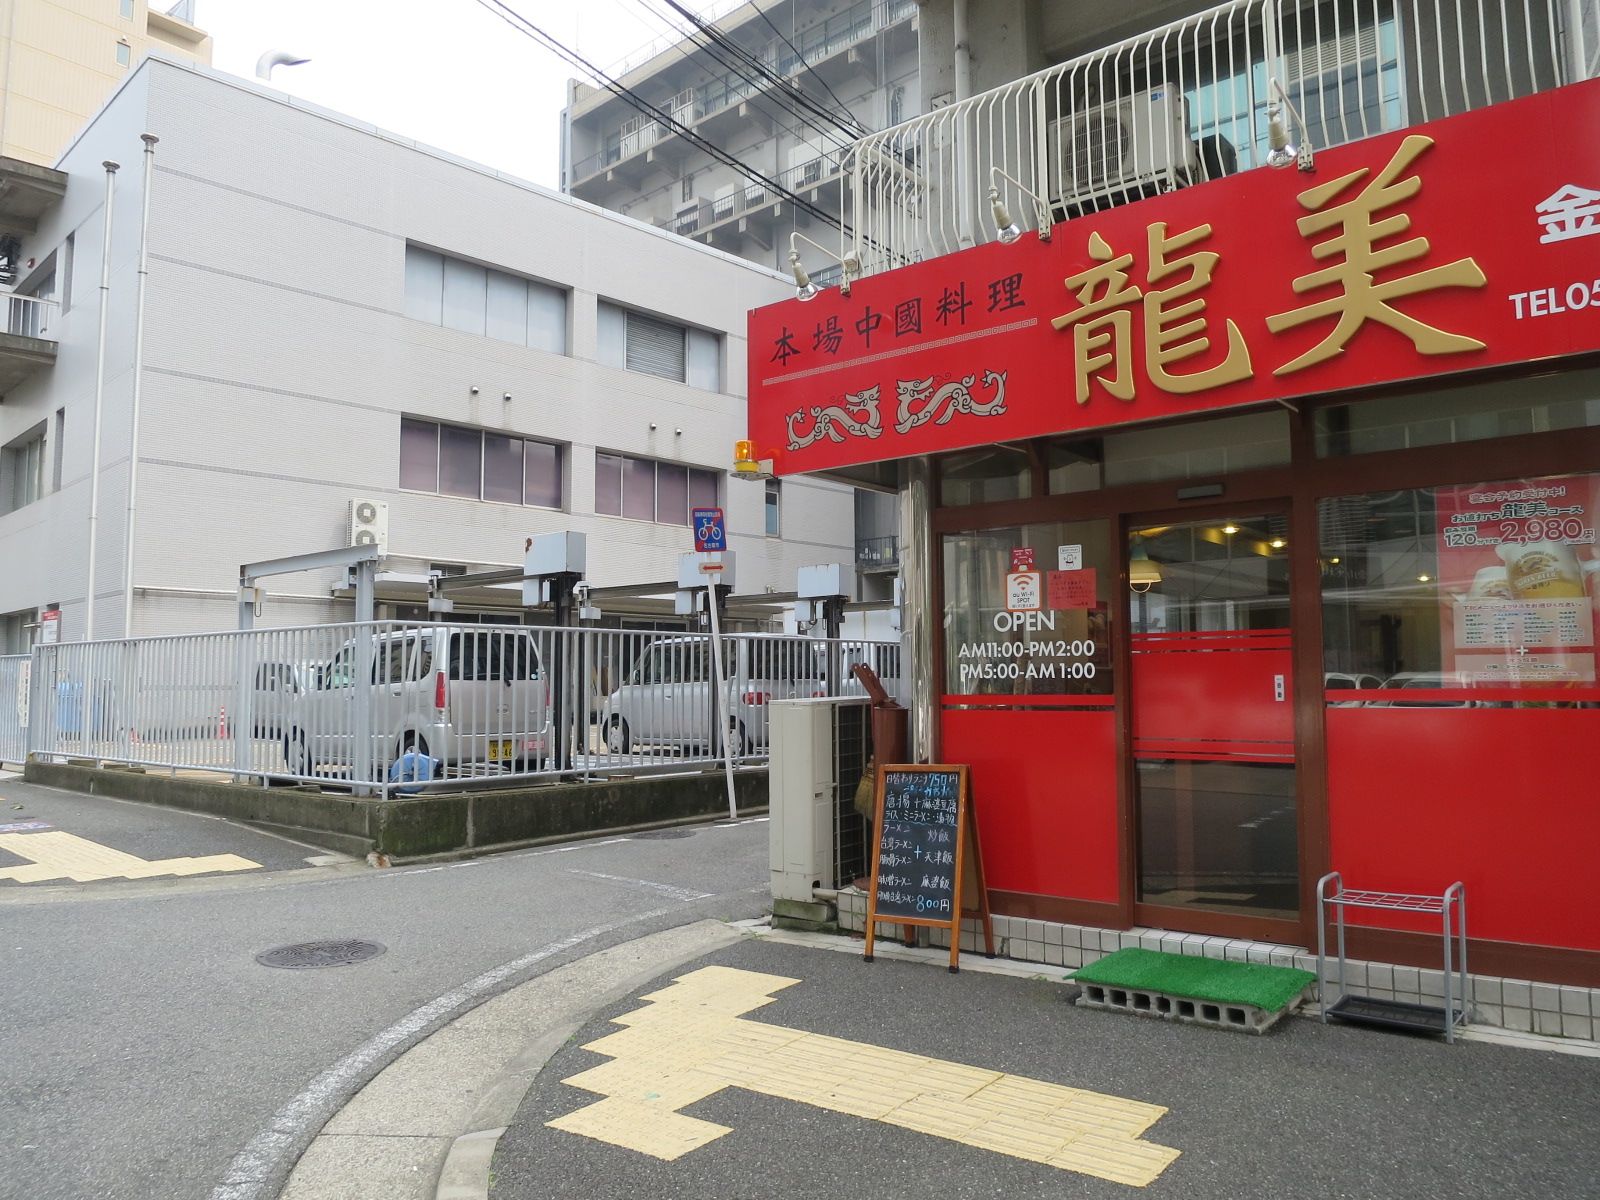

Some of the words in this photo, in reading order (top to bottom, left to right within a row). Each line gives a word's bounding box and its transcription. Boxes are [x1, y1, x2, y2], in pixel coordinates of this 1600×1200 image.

[1535, 184, 1600, 244] 金
[1051, 134, 1488, 406] 龍美
[770, 272, 1026, 367] 本場中國料理
[994, 610, 1055, 633] OPEN
[958, 640, 1095, 658] AM11:00-PM2:00
[916, 894, 950, 912] 800円
